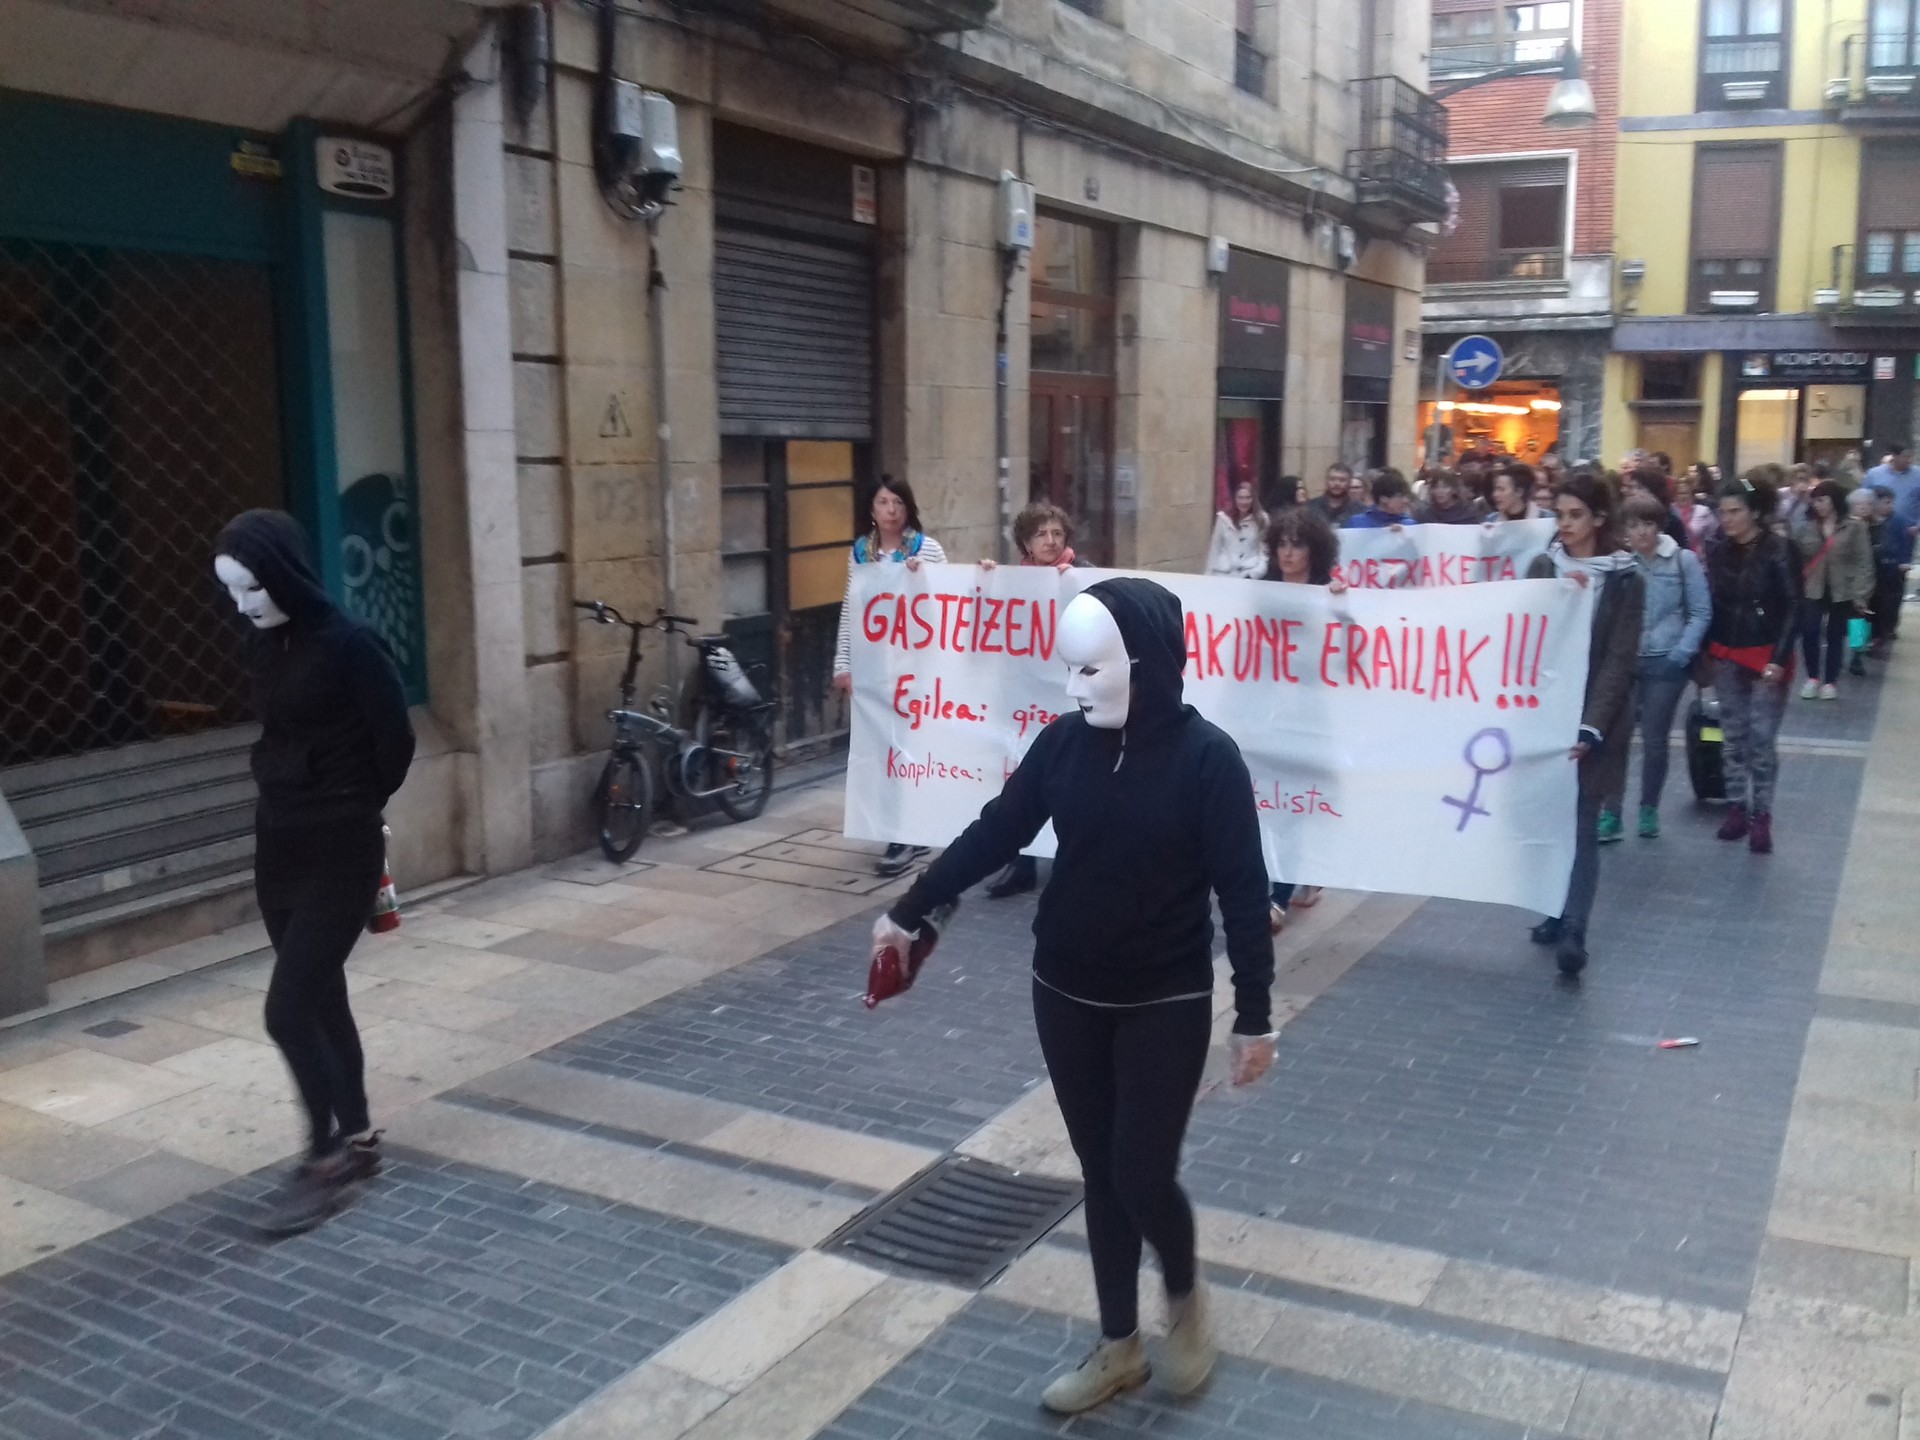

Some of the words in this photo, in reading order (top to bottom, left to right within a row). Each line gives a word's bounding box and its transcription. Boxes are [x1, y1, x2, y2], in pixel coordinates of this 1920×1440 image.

[1182, 611, 1303, 684] AKUME
[893, 674, 987, 730] Egilea:
[887, 746, 983, 787] Konplizea:
